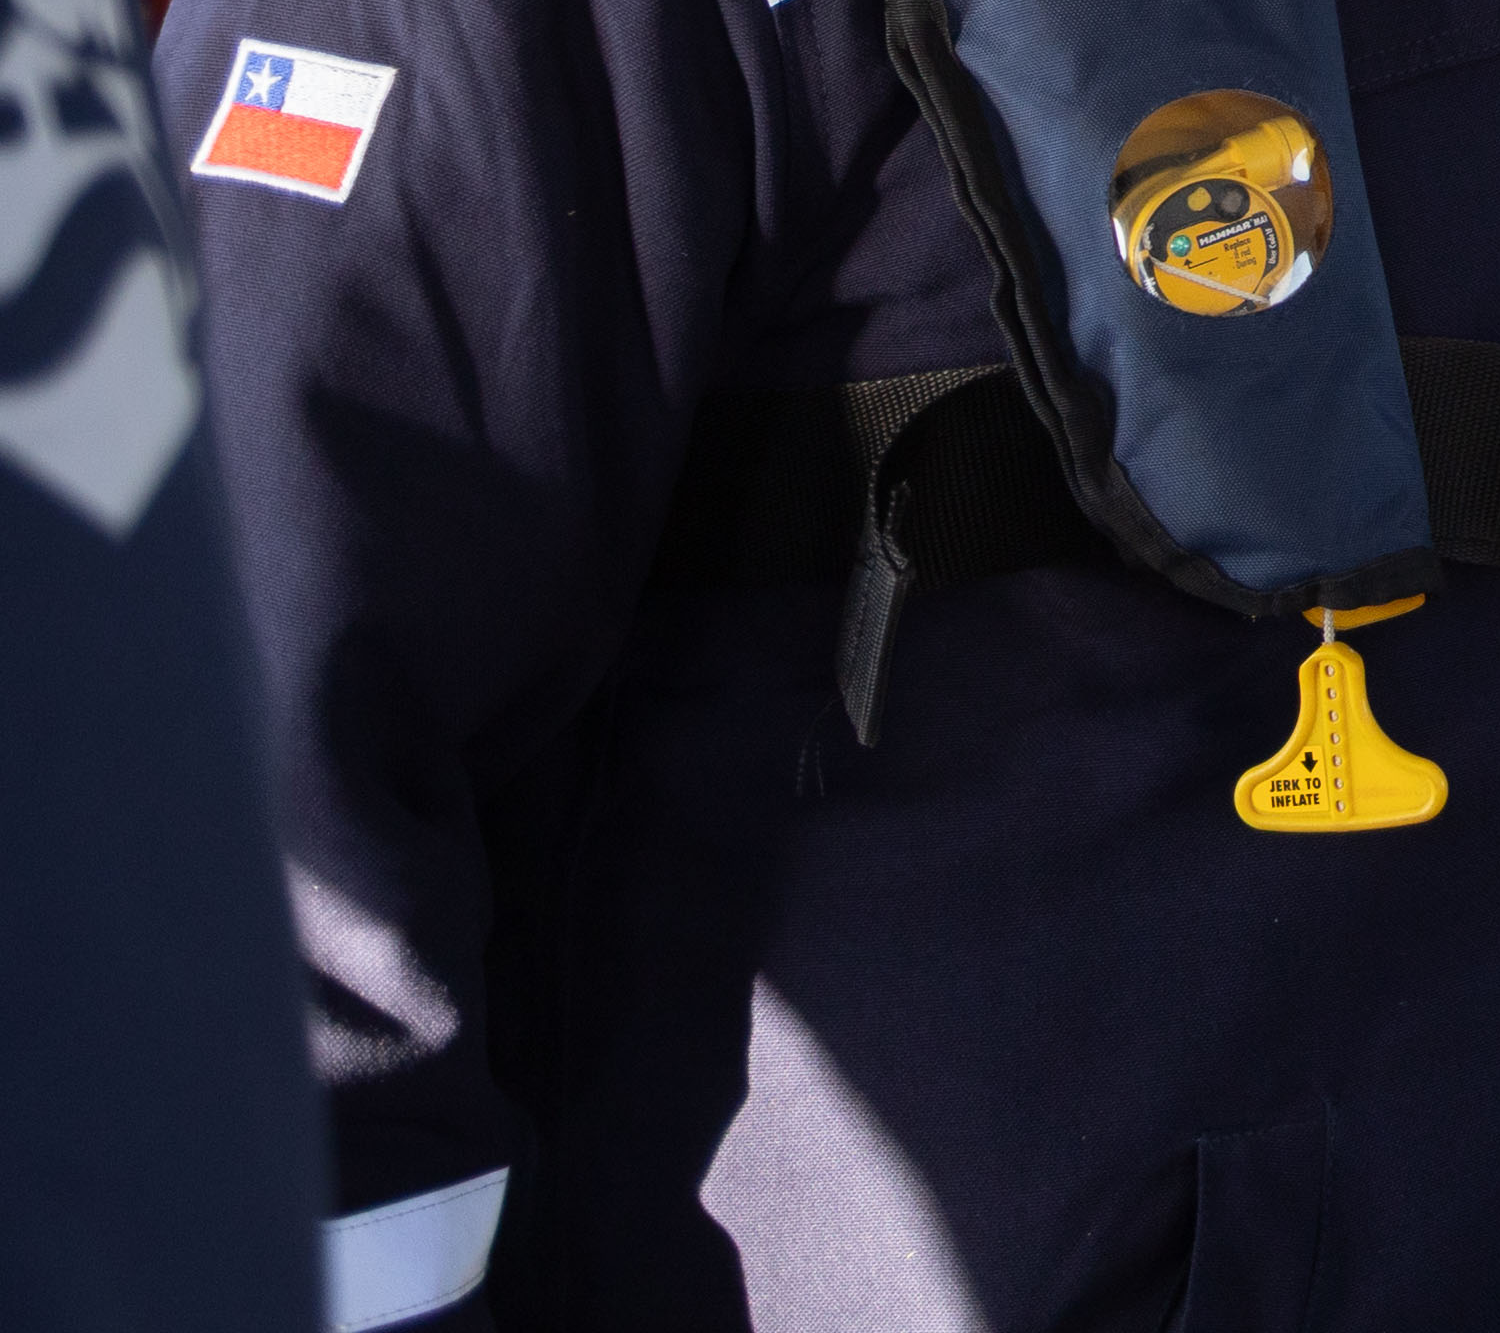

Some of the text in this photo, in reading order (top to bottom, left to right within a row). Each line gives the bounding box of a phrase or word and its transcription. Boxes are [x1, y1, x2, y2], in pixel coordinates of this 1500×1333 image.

[1270, 777, 1321, 792] JERK TO
[1271, 793, 1320, 808] INFLATE
